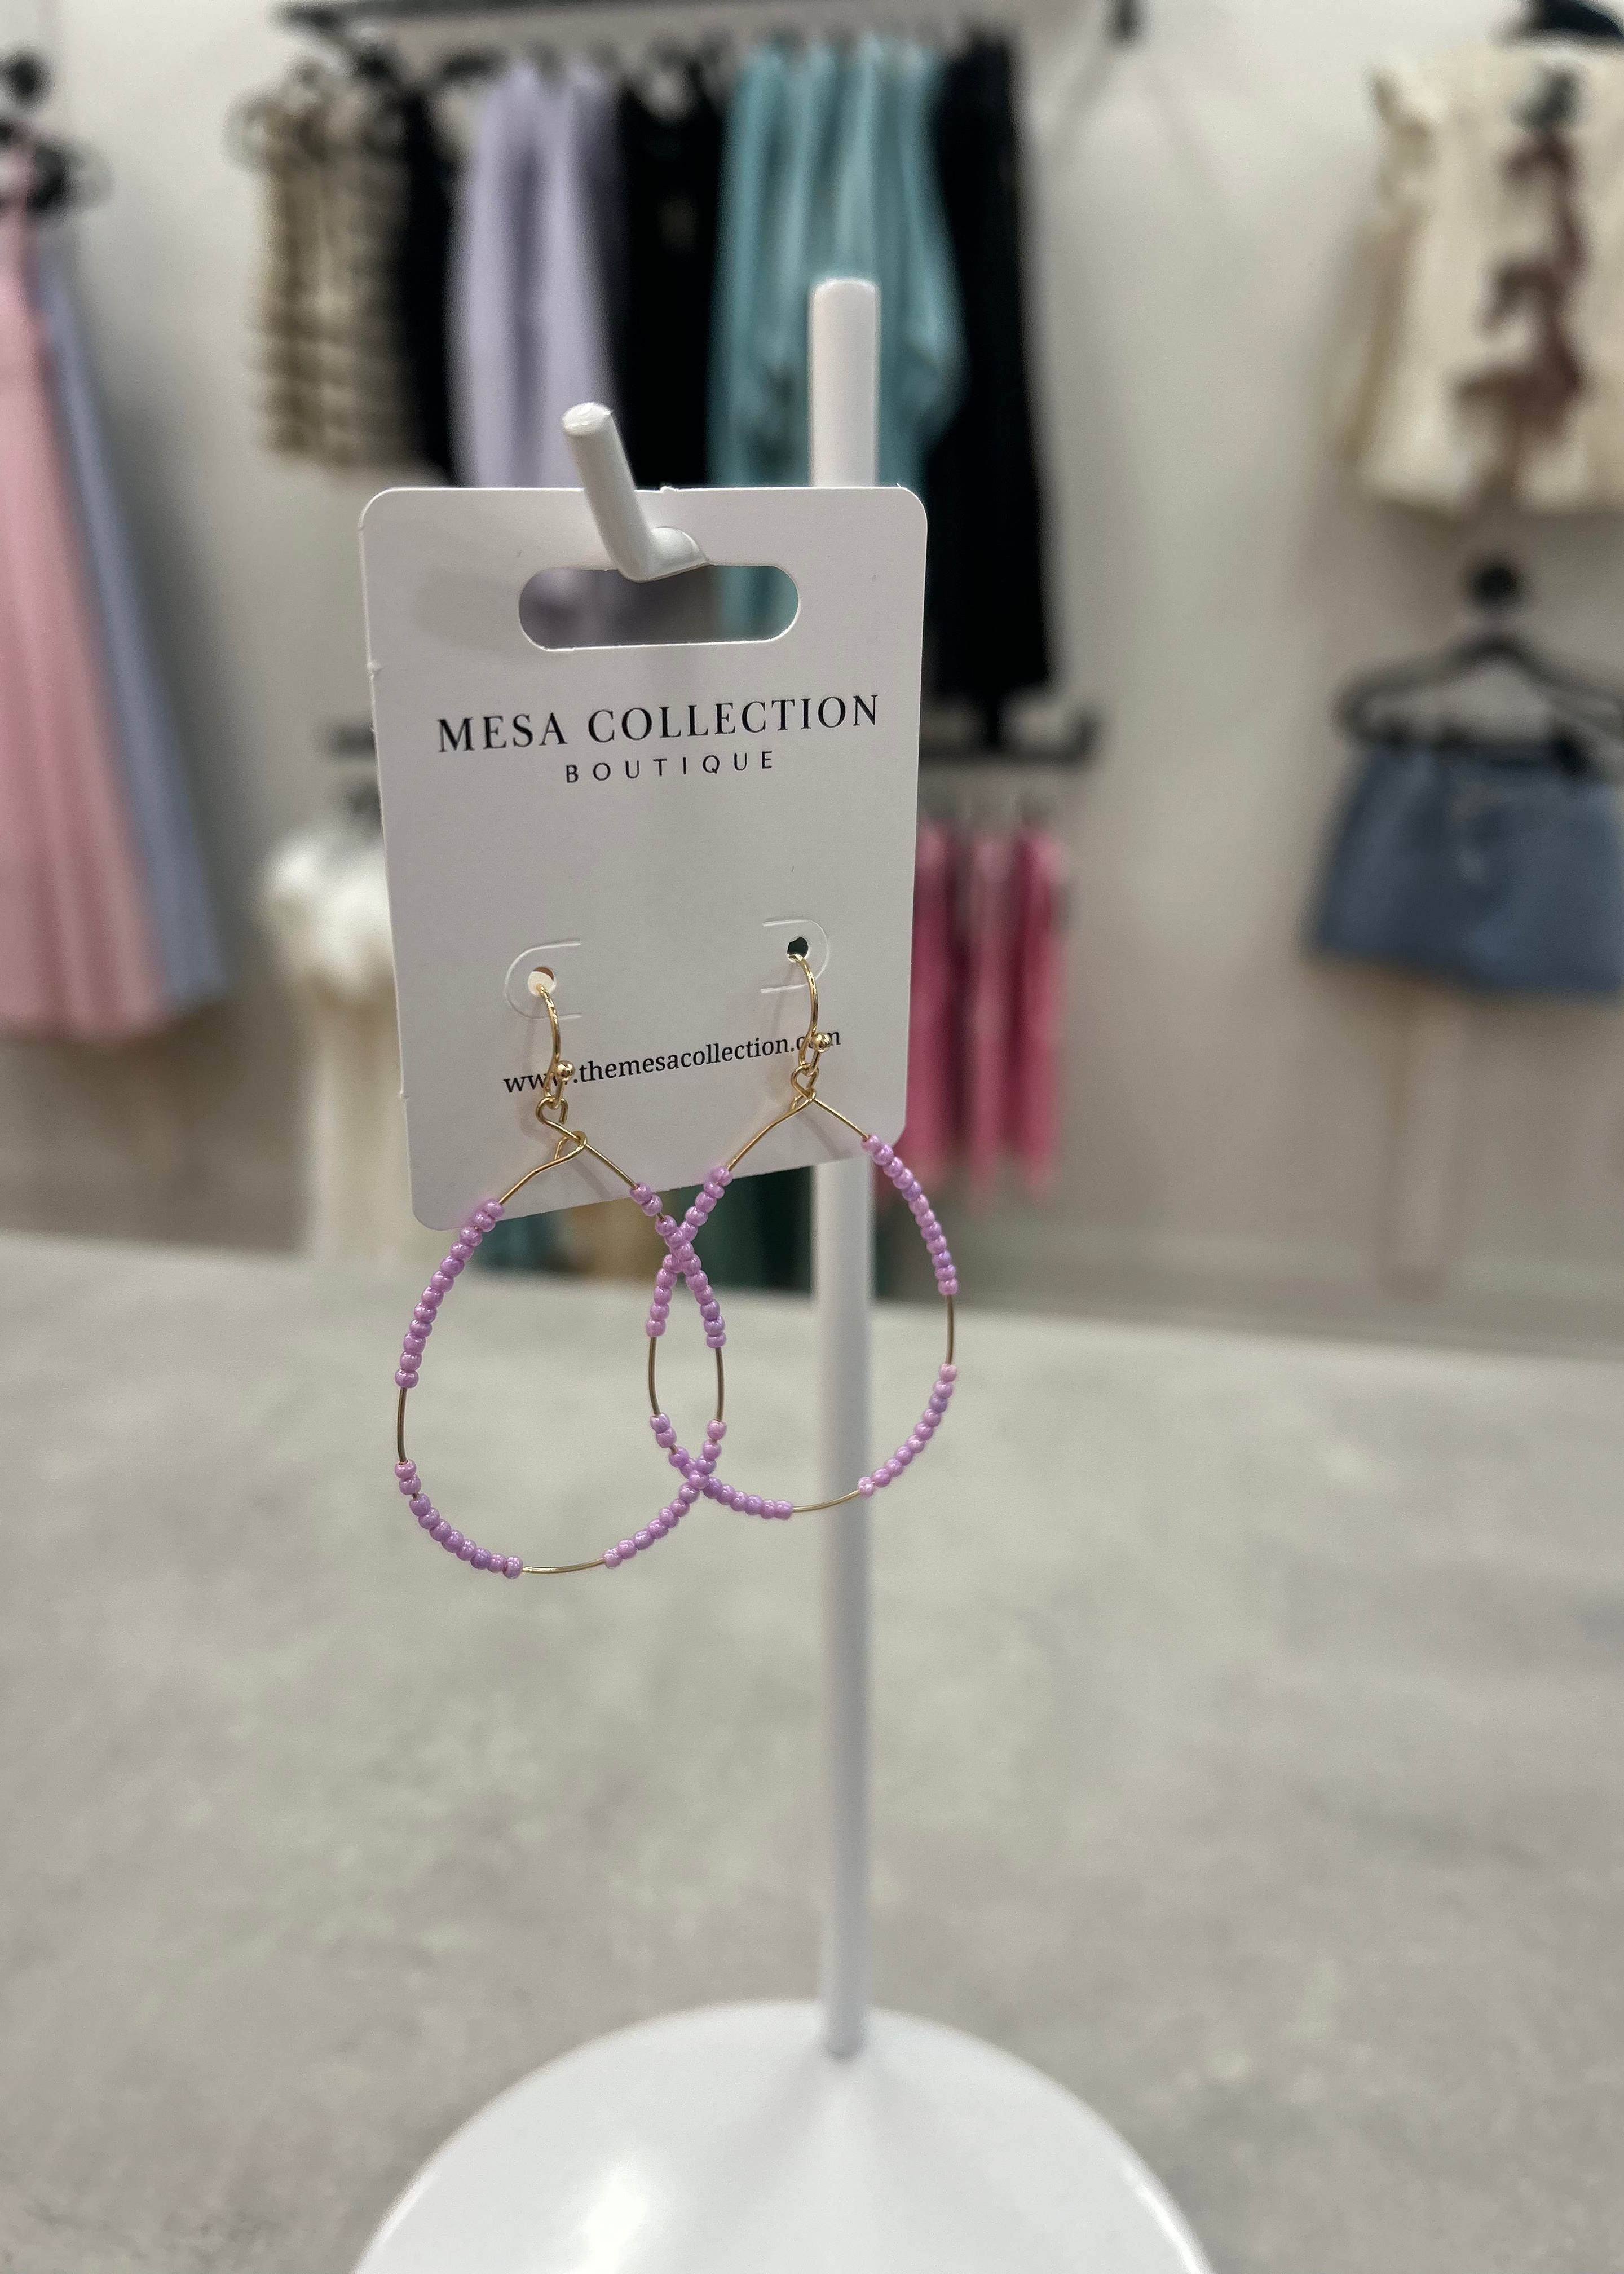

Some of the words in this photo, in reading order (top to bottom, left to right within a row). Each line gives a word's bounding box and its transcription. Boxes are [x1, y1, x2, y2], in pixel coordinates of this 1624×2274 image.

[437, 712, 568, 753] MESA
[588, 694, 879, 743] COLLECTION
[566, 750, 774, 783] BOUTIQUE
